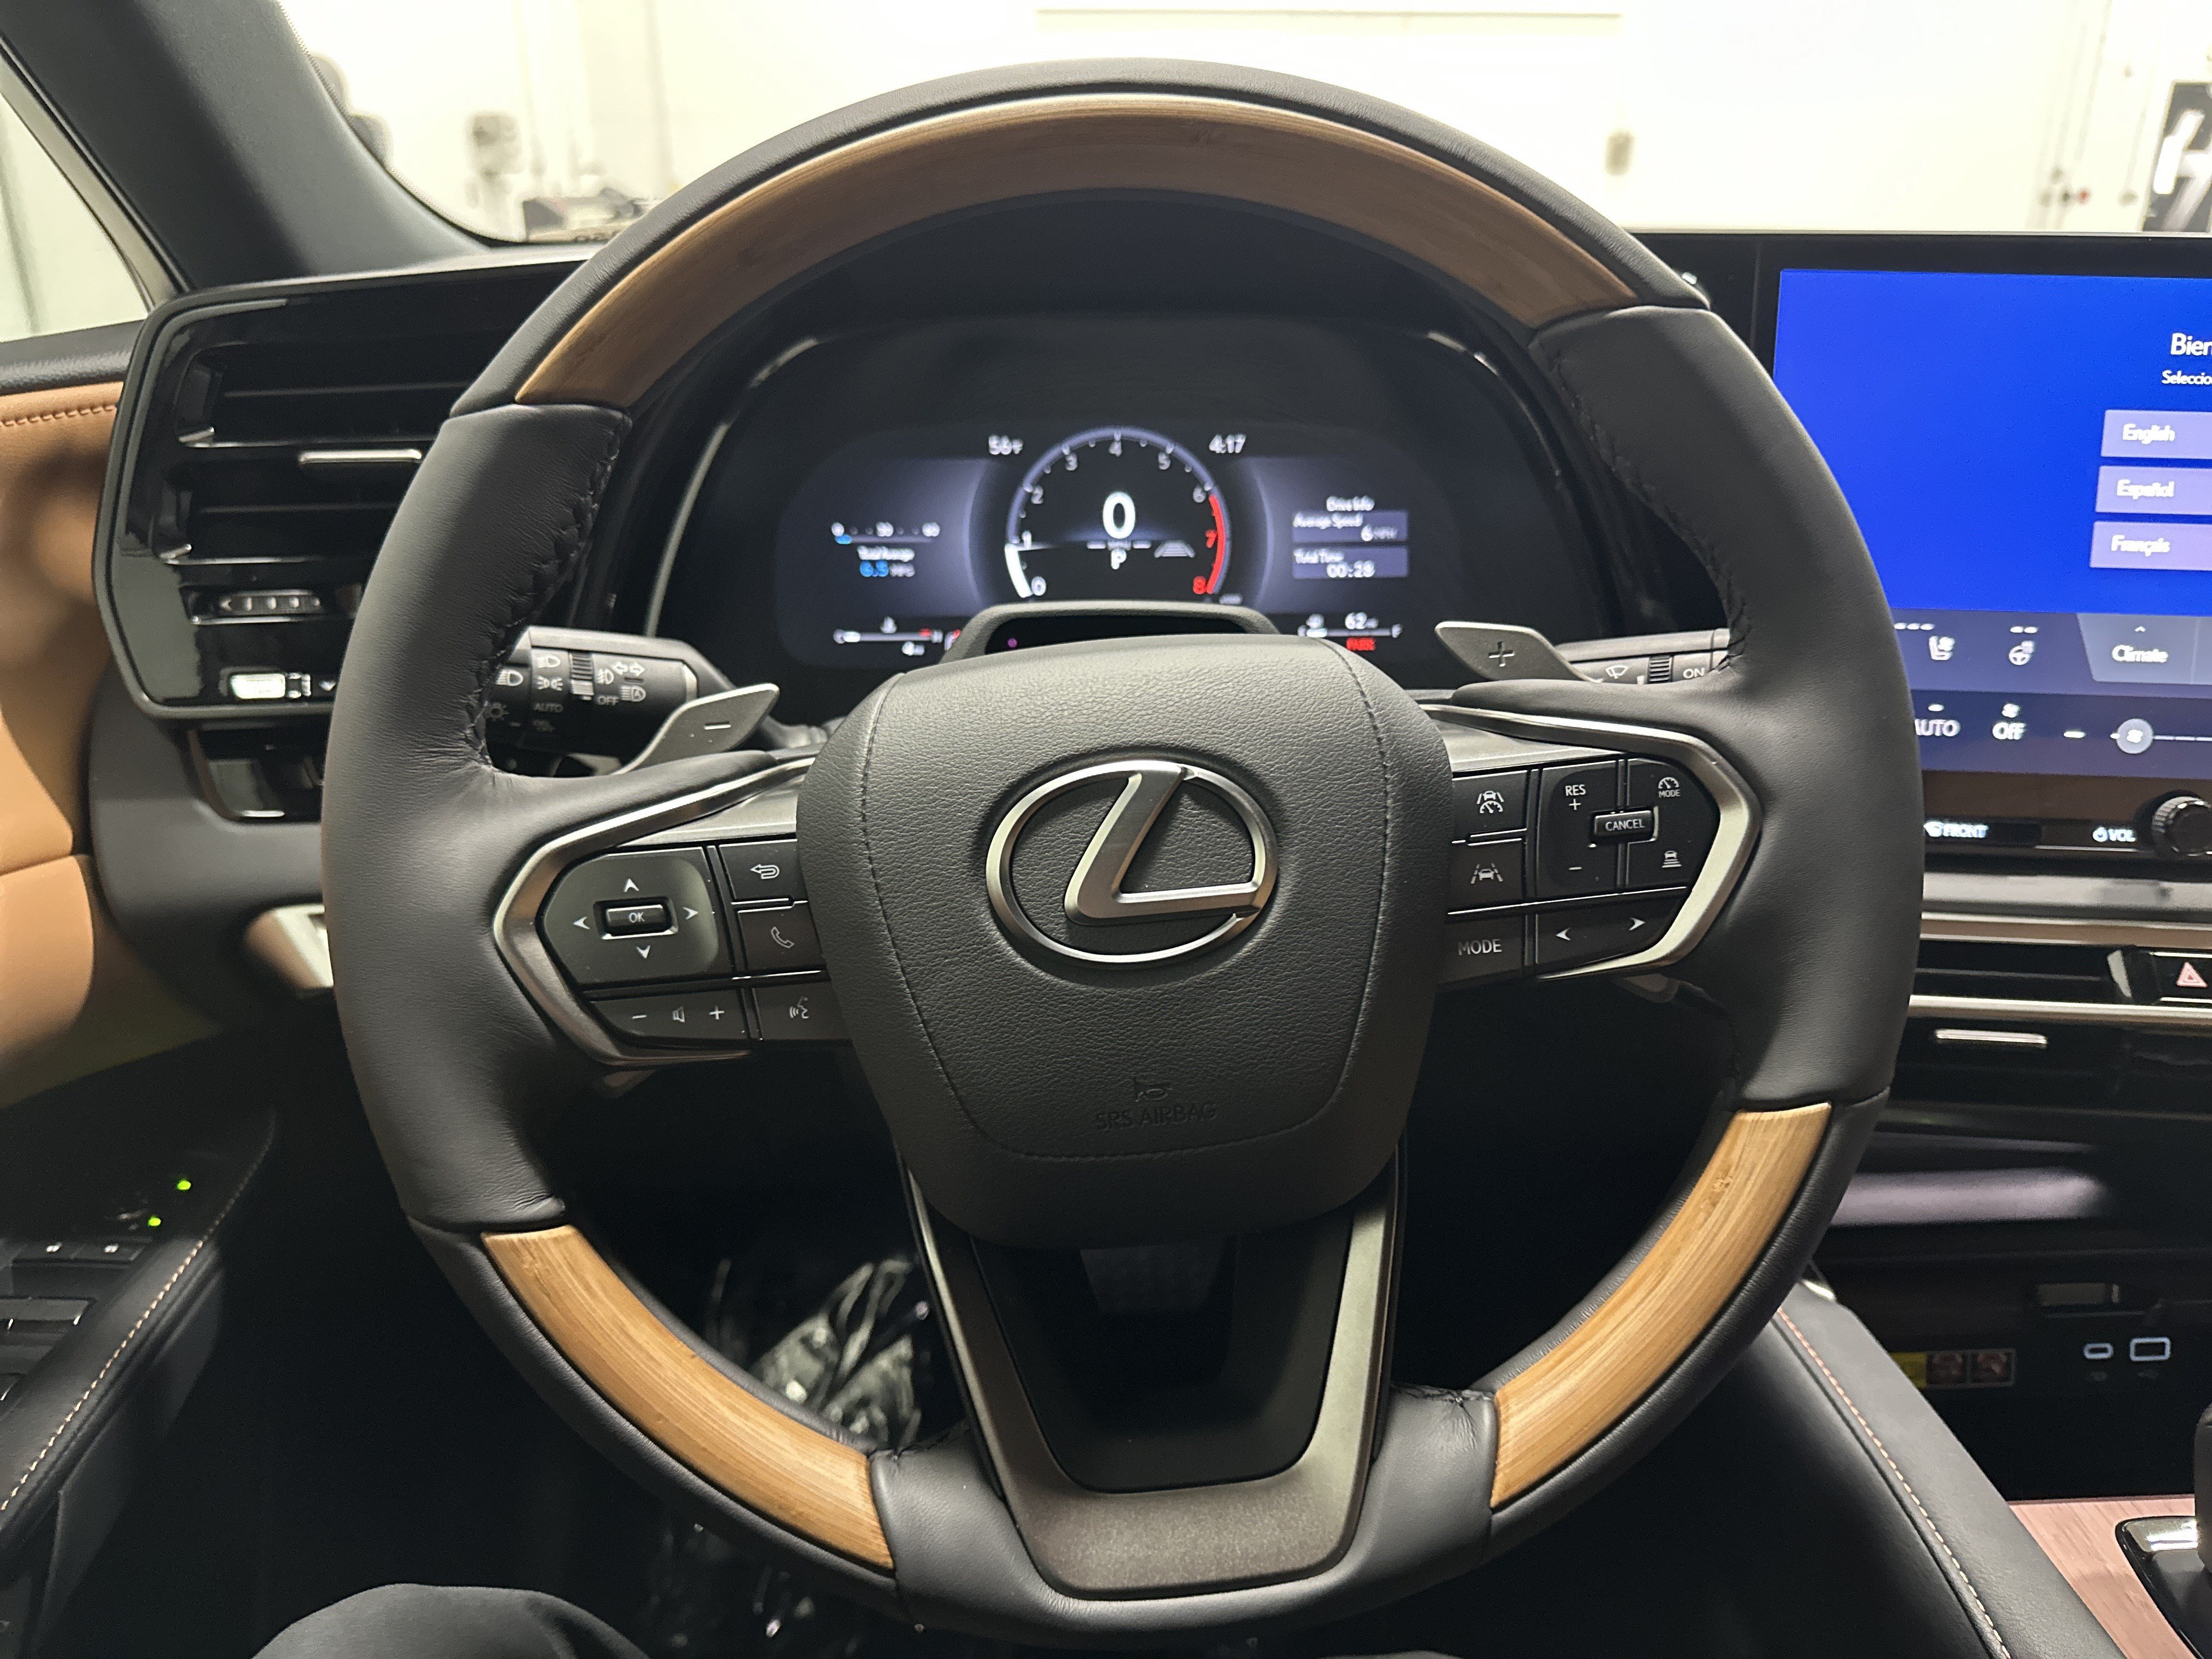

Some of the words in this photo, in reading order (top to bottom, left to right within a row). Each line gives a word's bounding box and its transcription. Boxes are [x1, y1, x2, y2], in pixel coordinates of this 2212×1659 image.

[2122, 423, 2176, 444] English
[1108, 440, 1122, 457] 4
[1209, 434, 1246, 454] 4:17
[1065, 453, 1078, 471] 3
[1158, 451, 1171, 470] 5
[1031, 485, 1044, 504] 2
[1193, 485, 1206, 504] 6
[2117, 479, 2175, 500] Español
[1103, 491, 1136, 539] 0
[1022, 530, 1032, 549] 1
[1205, 529, 1217, 548] 7
[2111, 534, 2171, 557] Français
[1111, 549, 1127, 570] P
[1031, 576, 1047, 596] 0
[1193, 575, 1206, 595] 8
[2112, 645, 2168, 663] Climate
[1683, 667, 1705, 679] ON
[533, 702, 564, 713] AUTO
[597, 695, 620, 707] OFF
[1992, 721, 2028, 740] Off
[1565, 784, 1586, 797] RES
[1658, 789, 1681, 798] MODE
[1605, 818, 1646, 831] CANCEL
[1943, 823, 1989, 838] FRONT
[2108, 828, 2137, 843] VOL
[628, 912, 646, 924] OK
[1458, 939, 1503, 956] MODE
[1095, 1109, 1133, 1131] SRS
[1140, 1101, 1217, 1125] AIRBAG
